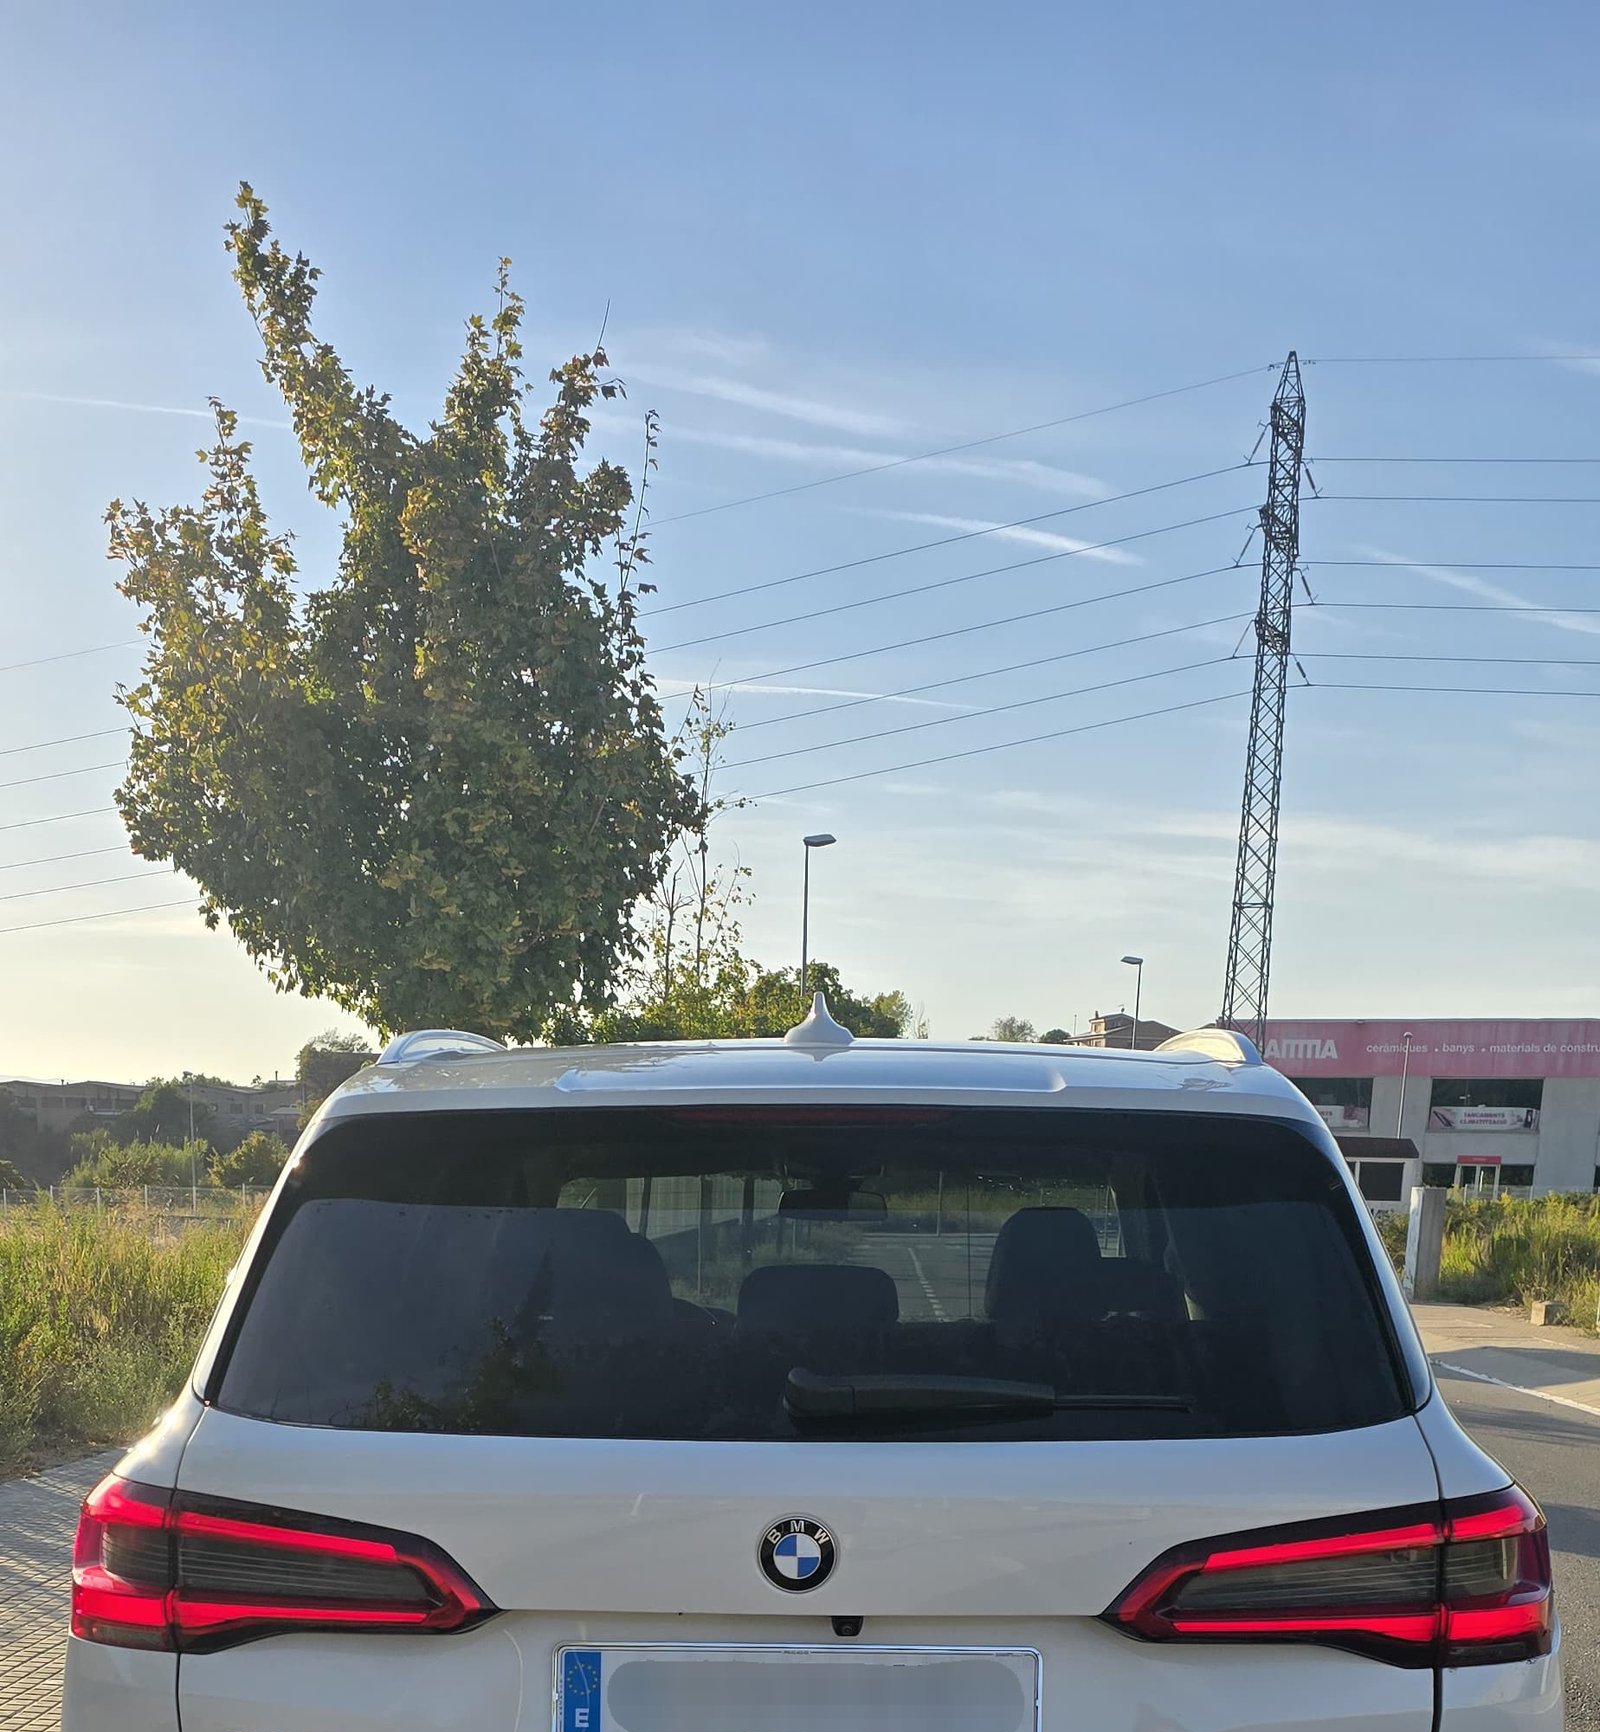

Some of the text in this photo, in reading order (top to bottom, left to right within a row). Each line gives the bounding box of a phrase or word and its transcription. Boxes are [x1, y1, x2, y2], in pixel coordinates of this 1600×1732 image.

[1442, 1043, 1475, 1055] banys
[1489, 1043, 1541, 1053] materials
[1543, 1043, 1557, 1053] de
[766, 1520, 829, 1545] BMW
[575, 1708, 589, 1728] E
